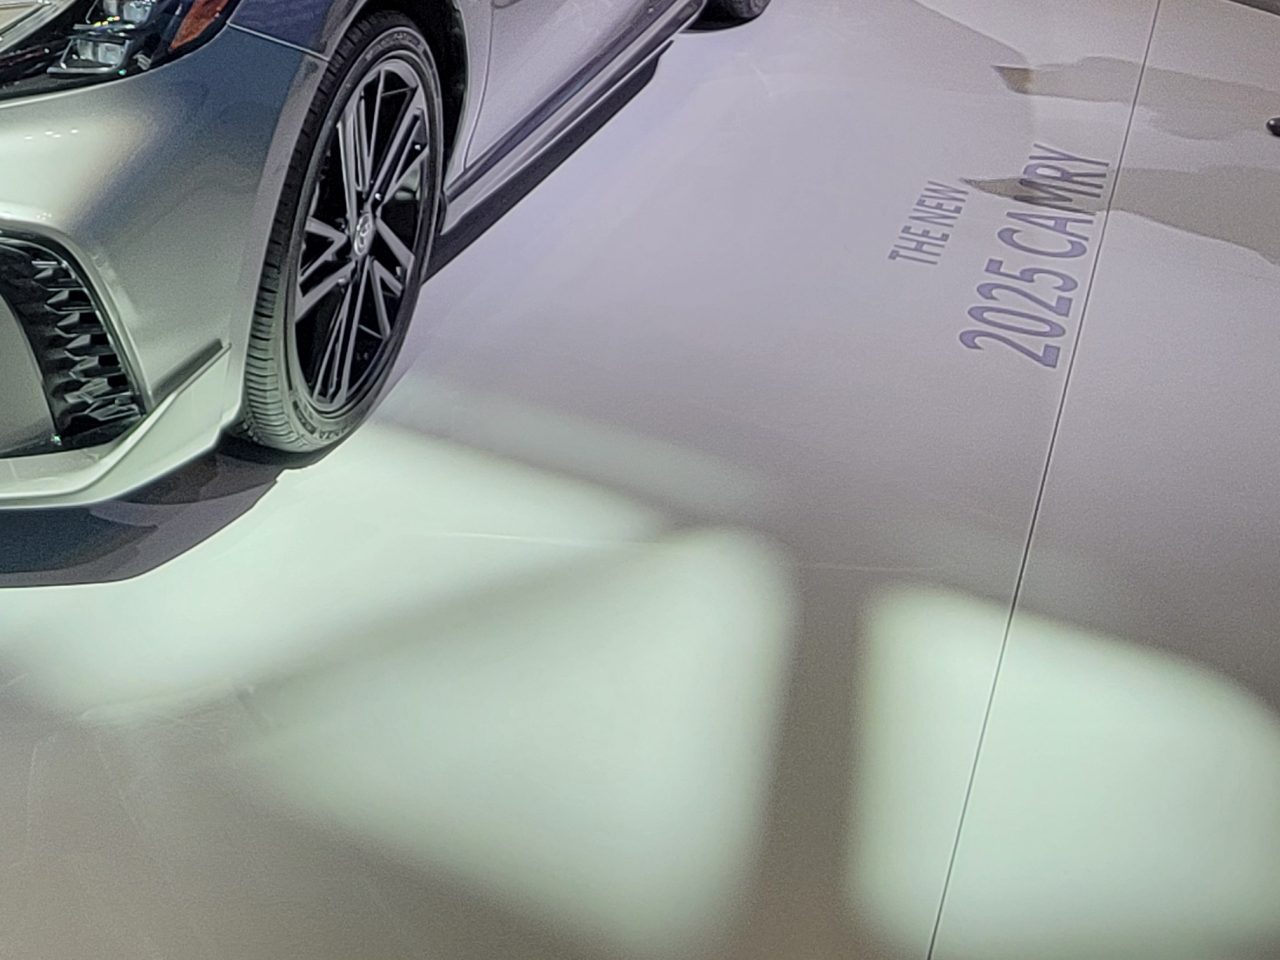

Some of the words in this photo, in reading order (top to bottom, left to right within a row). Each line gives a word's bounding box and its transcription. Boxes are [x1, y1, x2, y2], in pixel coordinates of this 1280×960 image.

[908, 180, 970, 228] NEW
[996, 142, 1111, 260] CAMRY
[887, 225, 951, 266] THE
[958, 257, 1079, 370] 2025
